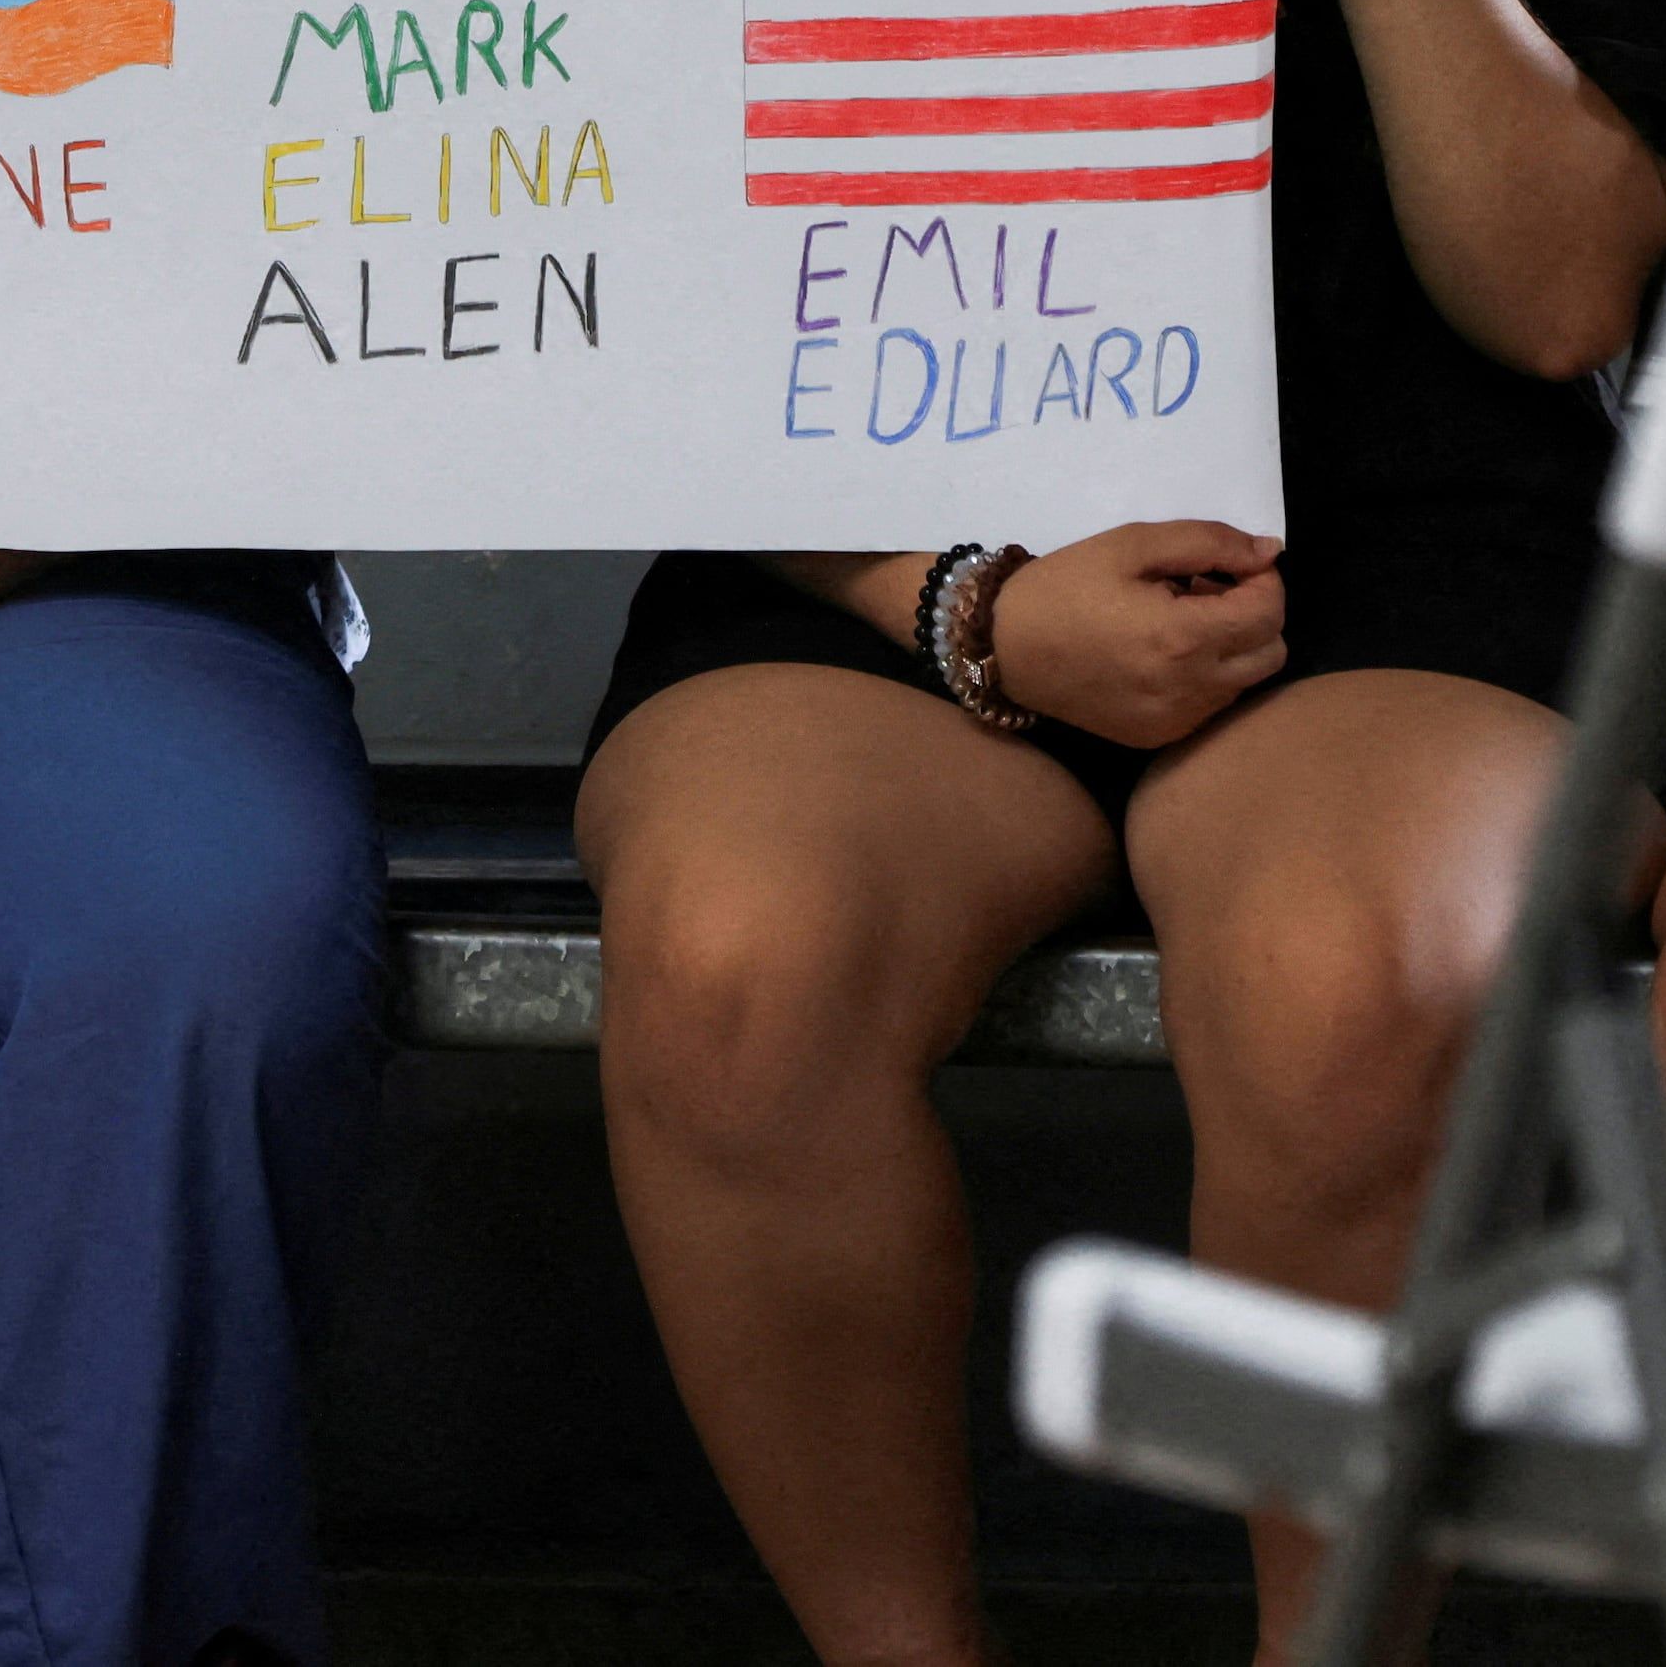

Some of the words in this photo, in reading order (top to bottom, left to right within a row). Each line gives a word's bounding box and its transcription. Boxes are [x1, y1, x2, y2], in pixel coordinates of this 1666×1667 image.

[262, 119, 615, 233] ELINA
[237, 252, 599, 365] ALEN
[795, 216, 1097, 331] EMIL
[785, 325, 1201, 446] EDUARD
